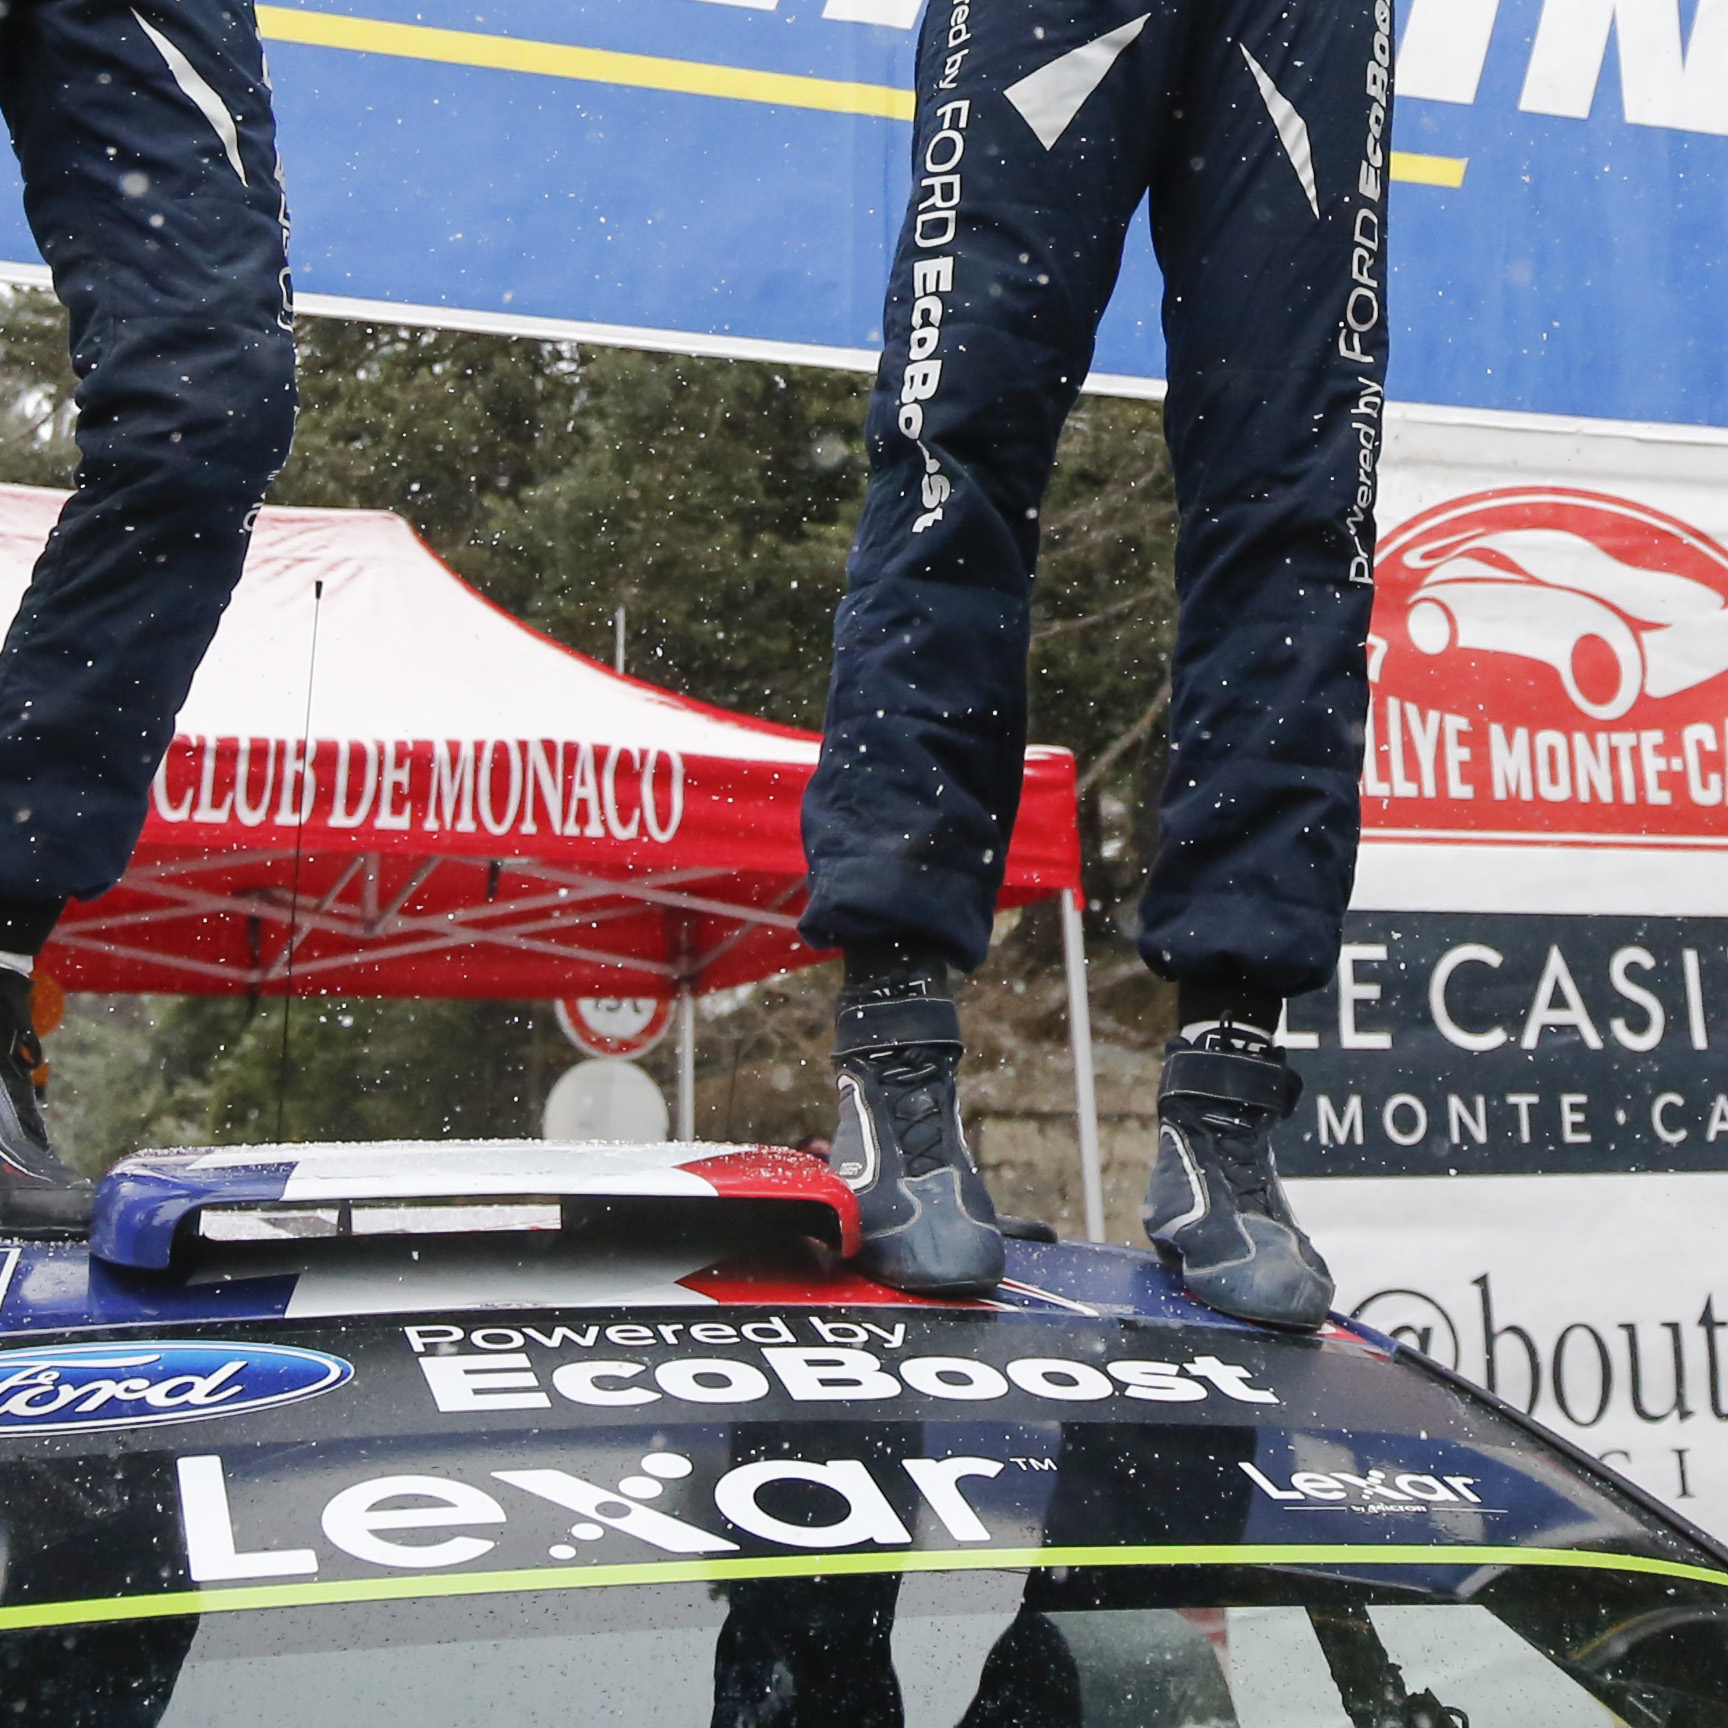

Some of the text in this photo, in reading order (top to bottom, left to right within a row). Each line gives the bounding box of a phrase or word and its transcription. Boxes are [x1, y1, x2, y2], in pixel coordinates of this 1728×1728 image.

[938, 49, 970, 90] by
[914, 99, 970, 248] FORD
[1338, 208, 1379, 363] FORD
[1351, 376, 1383, 415] by
[152, 734, 318, 827] CLUB
[327, 737, 412, 830] DE
[422, 738, 684, 843] MONACO
[1316, 1093, 1592, 1146] MONTE
[403, 1316, 908, 1353] Powered by
[418, 1347, 1279, 1414] EcoBoost
[1238, 1462, 1483, 1503] Lexar
[175, 1451, 1006, 1582] Lexar
